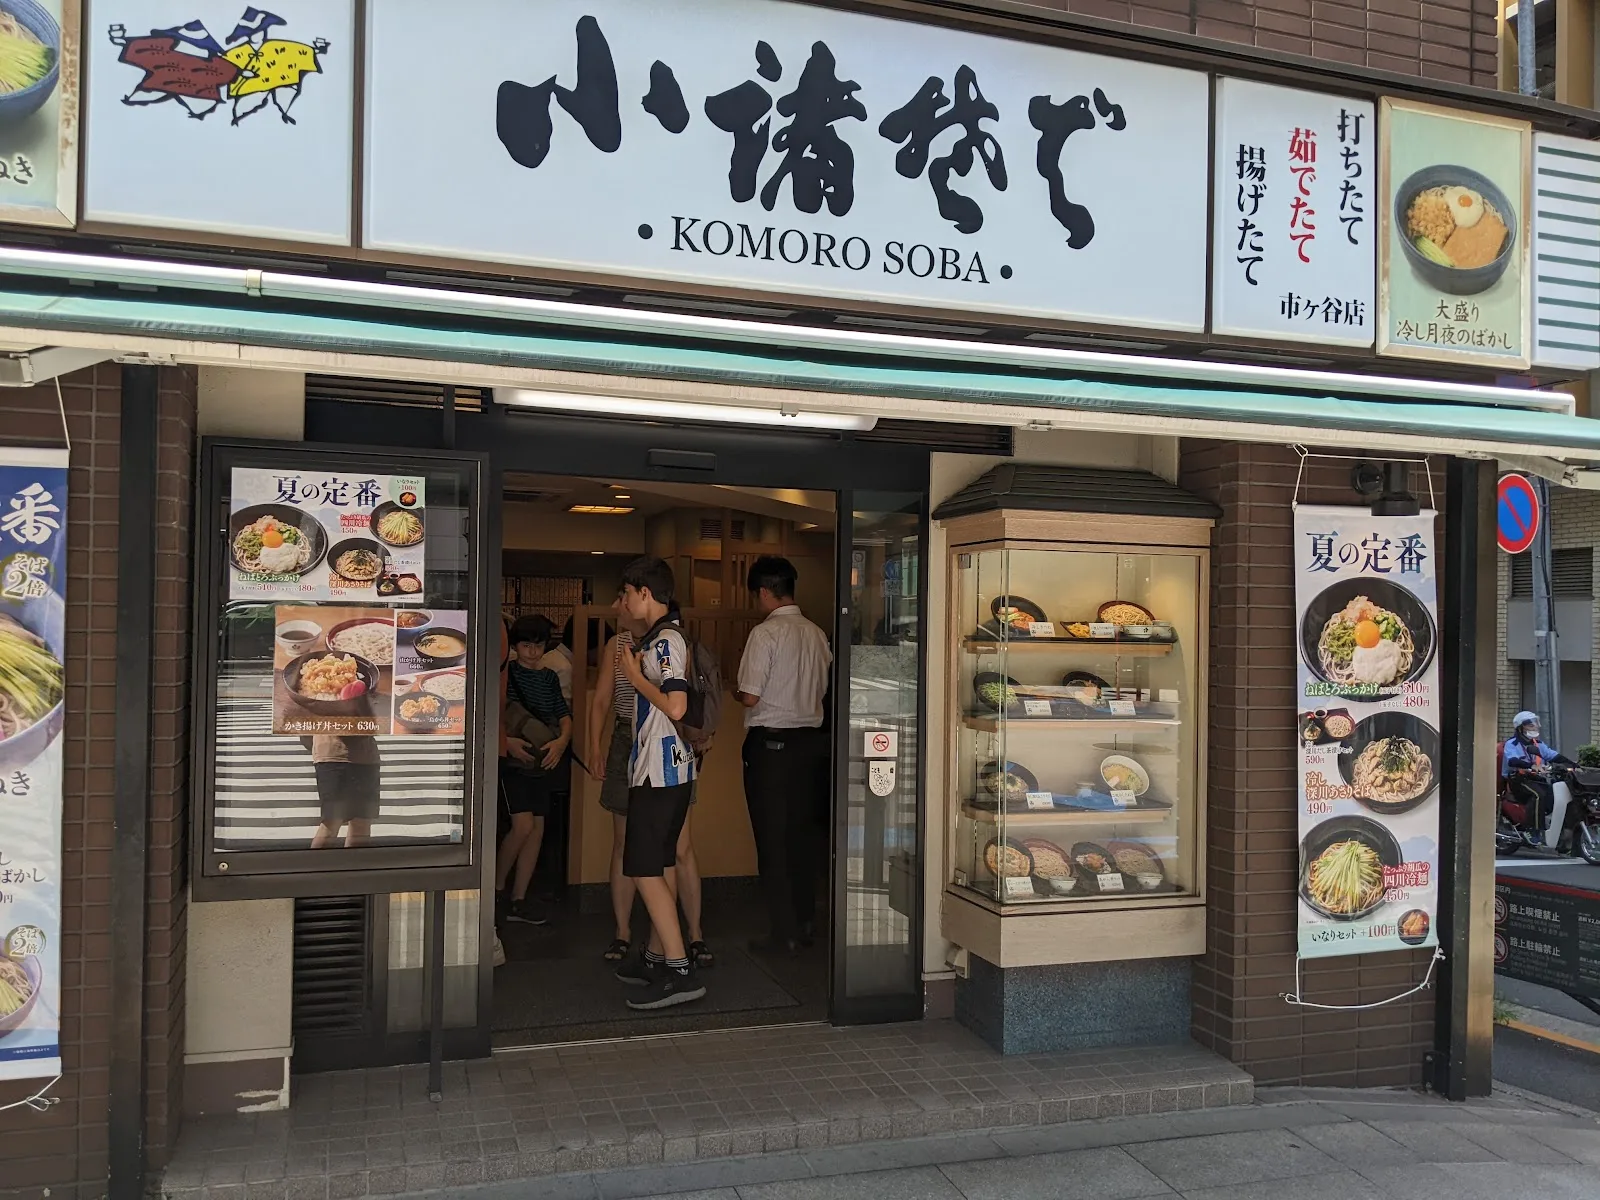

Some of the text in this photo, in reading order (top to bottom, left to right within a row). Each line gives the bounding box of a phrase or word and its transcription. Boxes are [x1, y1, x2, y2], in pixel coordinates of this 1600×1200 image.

[1337, 108, 1365, 245] 打ちたて
[1288, 127, 1317, 263] 茹でたて
[1236, 143, 1267, 286] 揚げたて
[670, 216, 990, 284] KOMORO SOBA
[1436, 299, 1480, 323] 大盛り
[1396, 321, 1513, 349] 冷し月夜のばかし
[272, 475, 382, 507] 夏の定番
[1306, 531, 1427, 573] 夏の定番
[13, 555, 48, 573] そば
[5, 570, 44, 597] 2倍
[1305, 682, 1379, 696] ねばとろぶっかけ
[1403, 682, 1430, 694] 510円
[1403, 696, 1430, 708] 480円
[285, 721, 380, 731] かき揚げ丼セット 630円
[1305, 755, 1324, 764] 590円
[1306, 772, 1326, 786] 冷し
[1306, 785, 1371, 800] 深川あさりそば
[1307, 802, 1332, 814] 490円
[1385, 888, 1409, 902] 450円
[1510, 903, 1560, 922] 路上喫煙禁止
[1312, 929, 1356, 942] いなりセット
